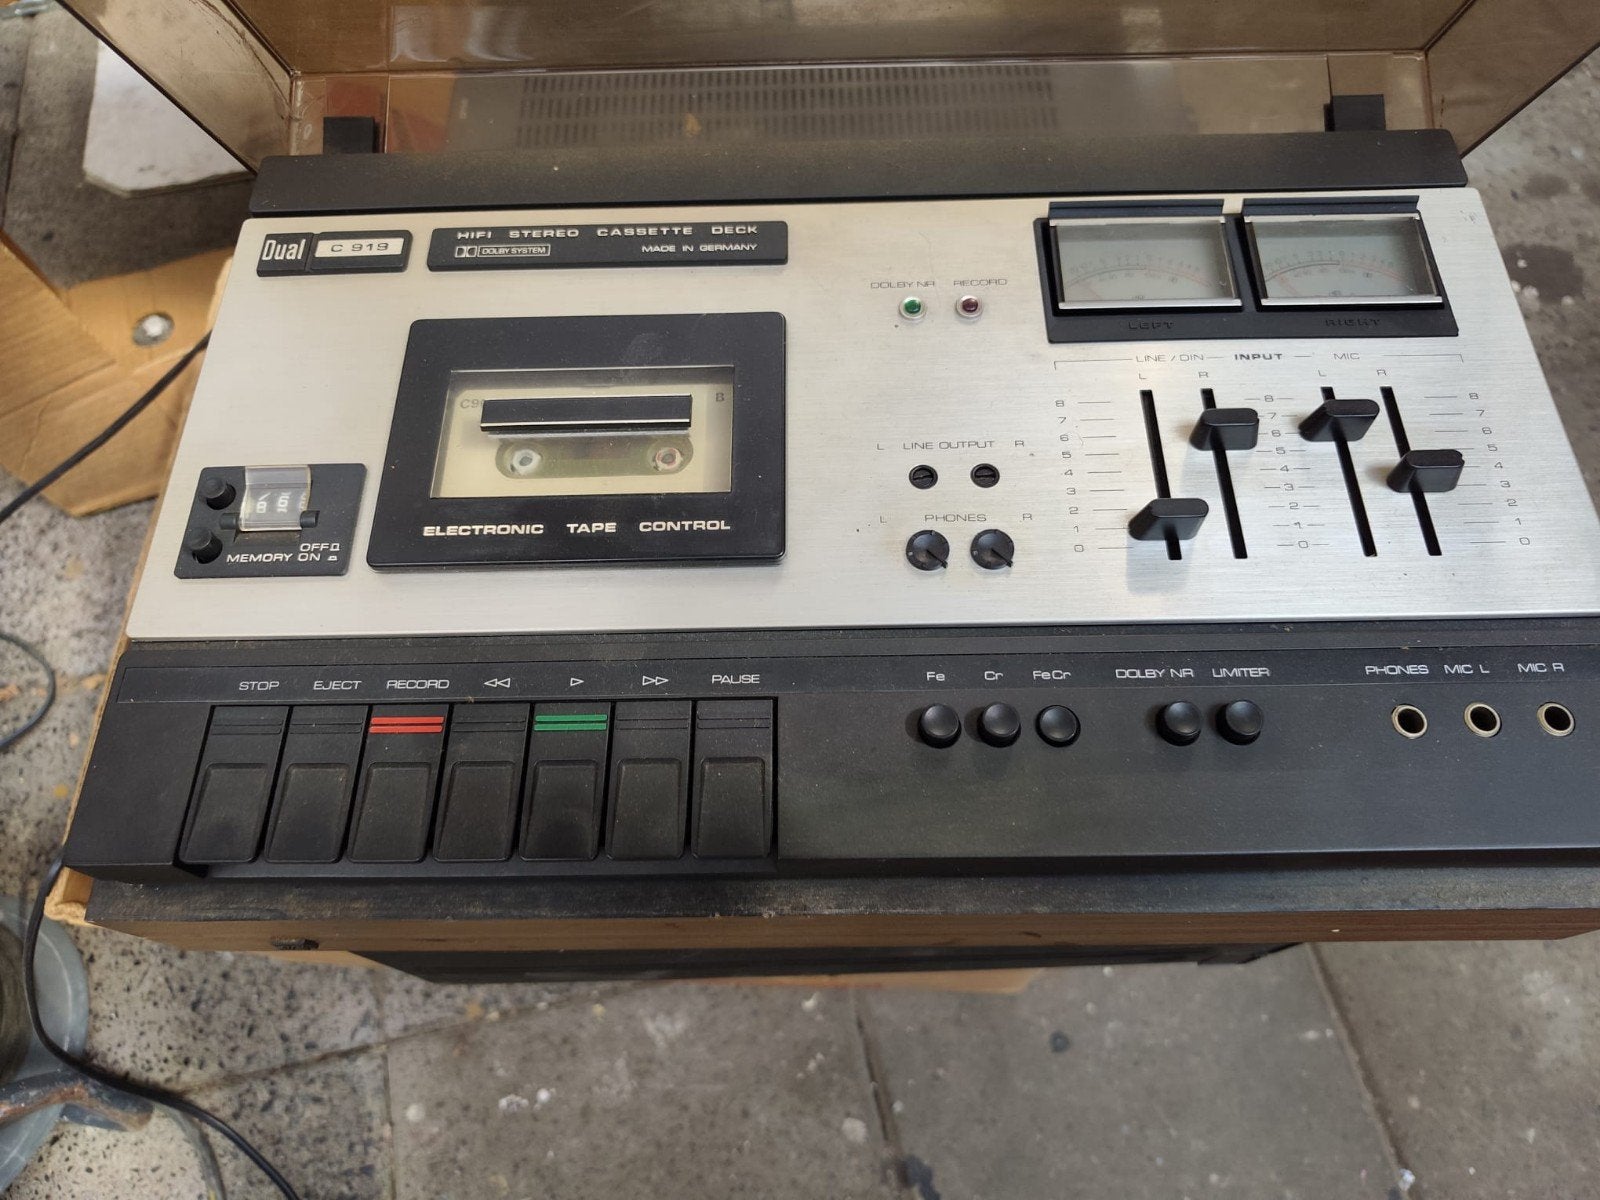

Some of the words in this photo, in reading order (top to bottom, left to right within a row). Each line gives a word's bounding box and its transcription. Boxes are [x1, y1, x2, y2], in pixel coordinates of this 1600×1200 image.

[457, 231, 493, 240] HIFI
[509, 229, 580, 239] STEREO
[597, 227, 693, 237] CASSETTE
[711, 225, 759, 235] DECK
[261, 239, 306, 261] Dual
[330, 244, 343, 253] C
[351, 242, 390, 252] 919
[511, 246, 546, 254] SYSTEM
[641, 245, 676, 253] MADE
[682, 244, 694, 252] IN
[699, 243, 758, 252] GERMANY
[870, 281, 914, 289] DOLBY
[916, 280, 935, 288] NR
[953, 278, 1008, 287] RECORD
[1128, 321, 1174, 330] LEFT
[1325, 318, 1381, 327] RIGHT
[1234, 353, 1283, 361] INPUT
[1333, 352, 1361, 360] MIC
[1264, 394, 1274, 402] 8
[1468, 392, 1479, 400] 8
[460, 398, 484, 409] C9
[1055, 400, 1065, 408] 8
[1268, 412, 1277, 420] 7
[1476, 409, 1485, 417] 7
[1057, 416, 1067, 424] 7
[1482, 426, 1492, 435] 6
[1059, 434, 1069, 442] 6
[903, 442, 934, 450] LINE
[938, 440, 995, 449] OUTPUT
[1487, 444, 1498, 452] 5
[1061, 451, 1072, 459] 5
[1275, 447, 1286, 455] 5
[1279, 465, 1289, 473] 4
[1494, 461, 1503, 469] 4
[1064, 469, 1074, 477] 4
[1283, 483, 1294, 491] 3
[1500, 480, 1511, 488] 3
[1066, 487, 1076, 495] 3
[1288, 502, 1298, 510] 2
[1507, 498, 1518, 507] 2
[1069, 506, 1079, 515] 2
[924, 514, 987, 522] PHONES
[1022, 513, 1033, 521] R
[423, 523, 544, 537] ELECTRONIC
[566, 522, 617, 533] TAPE
[638, 520, 731, 532] CONTROL
[1298, 540, 1309, 548] 0
[1519, 537, 1530, 545] 0
[300, 542, 330, 552] OFF
[1074, 544, 1084, 552] 0
[226, 553, 293, 563] MEMORY
[297, 552, 321, 562] ON
[1365, 664, 1429, 675] PHONES
[1443, 664, 1474, 674] MIC
[1479, 664, 1490, 674] L
[1517, 663, 1547, 673] MIC
[1552, 662, 1565, 673] R
[926, 671, 945, 681] Fe
[984, 671, 1003, 681] Cr
[1115, 668, 1165, 678] DOLBY
[1169, 668, 1194, 678] NR
[1212, 667, 1271, 678] LIMITER
[711, 674, 760, 684] PAUSE
[238, 680, 280, 691] STOP
[313, 680, 362, 690] EJECT
[386, 678, 450, 690] RECORD
